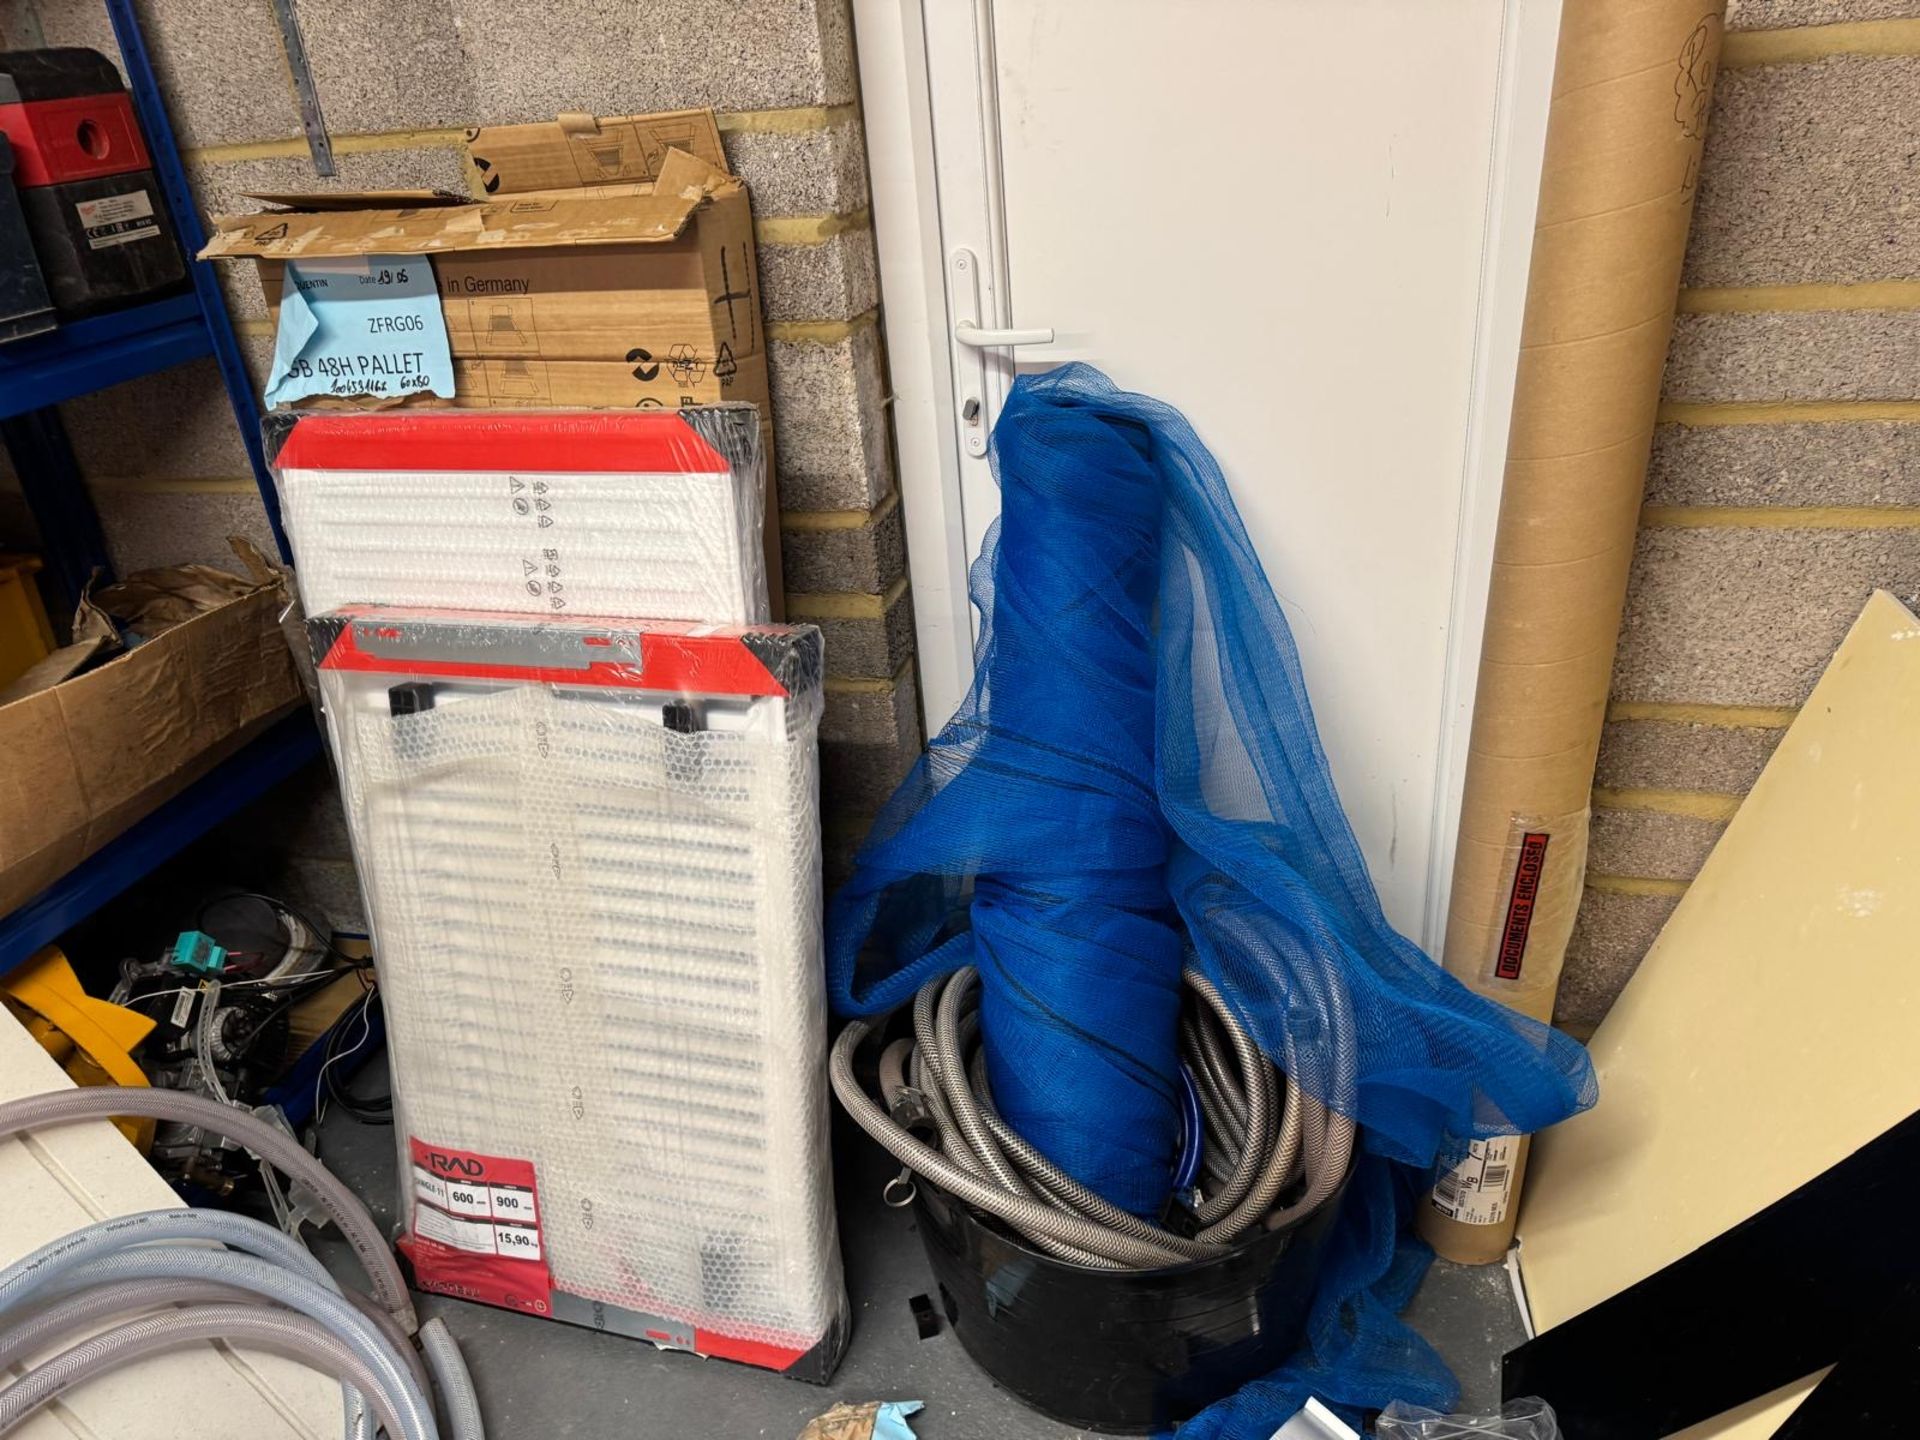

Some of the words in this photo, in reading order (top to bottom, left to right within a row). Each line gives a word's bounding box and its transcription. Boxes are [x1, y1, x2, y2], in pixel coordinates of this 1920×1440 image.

[359, 274, 377, 285] Date
[446, 275, 460, 293] in
[464, 275, 530, 296] Germany
[367, 314, 425, 334] ZFRG06
[318, 356, 355, 377] 48H
[357, 352, 424, 376] PALLET
[1501, 903, 1530, 973] DOCUMENTS
[1516, 840, 1544, 901] ENCLOSED
[452, 1191, 474, 1204] 600
[496, 1195, 519, 1208] 900
[498, 1231, 530, 1246] 15,90
